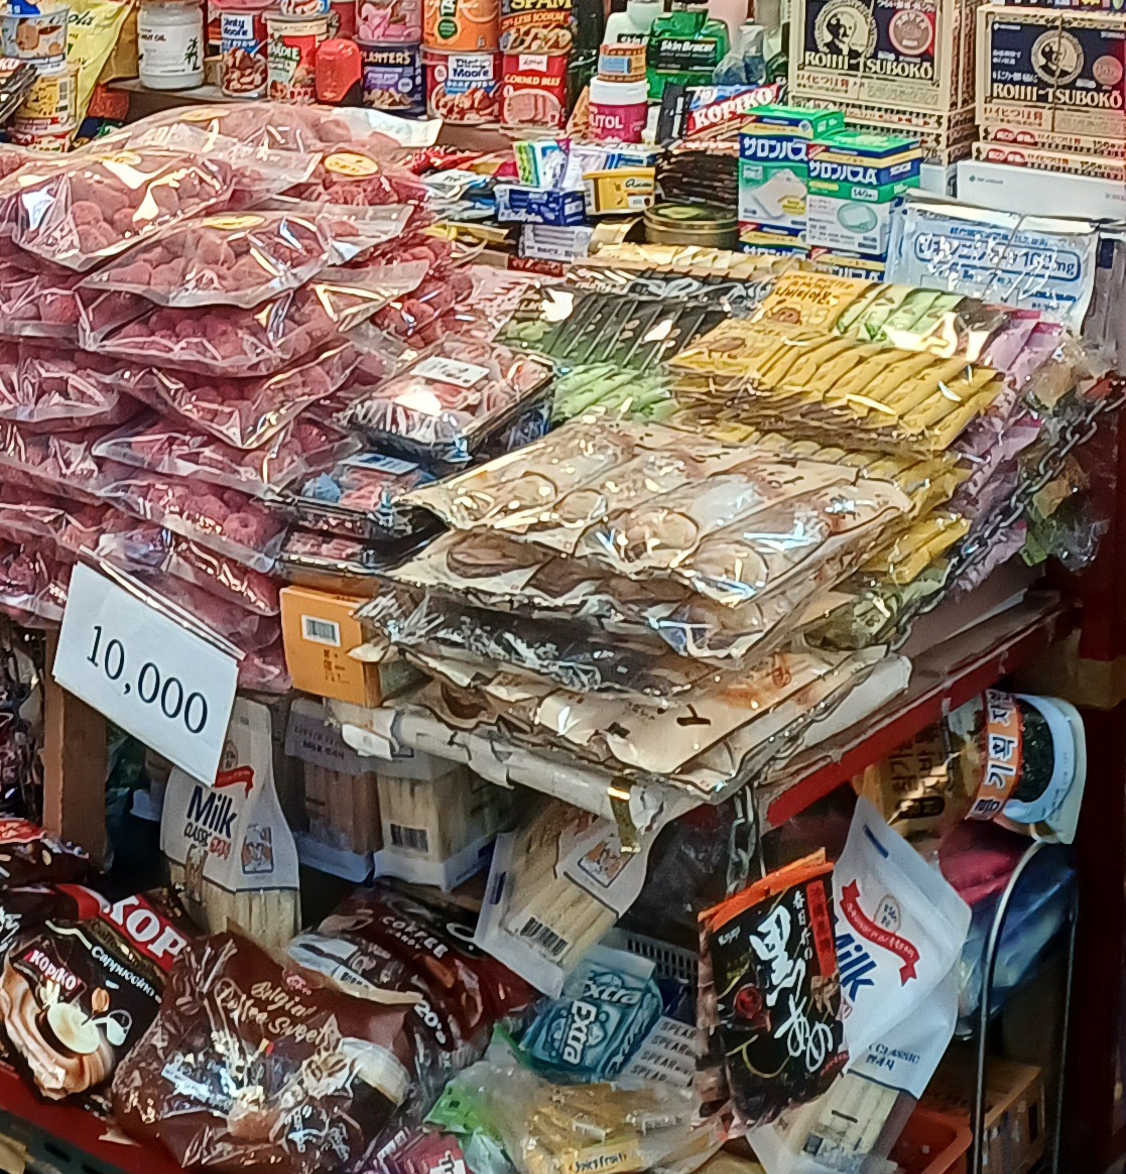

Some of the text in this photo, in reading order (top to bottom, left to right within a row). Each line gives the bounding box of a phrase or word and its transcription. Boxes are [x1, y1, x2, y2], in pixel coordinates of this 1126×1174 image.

[661, 39, 717, 54] Skin Bracer
[452, 67, 491, 79] Moore
[692, 85, 776, 130] KOPIKO
[742, 136, 809, 162] サロンパス
[808, 159, 879, 186] サロンパスA
[86, 625, 209, 735] 10,000
[187, 784, 239, 839] Milk
[102, 894, 192, 962] KOP
[29, 946, 80, 991] KOPIKO
